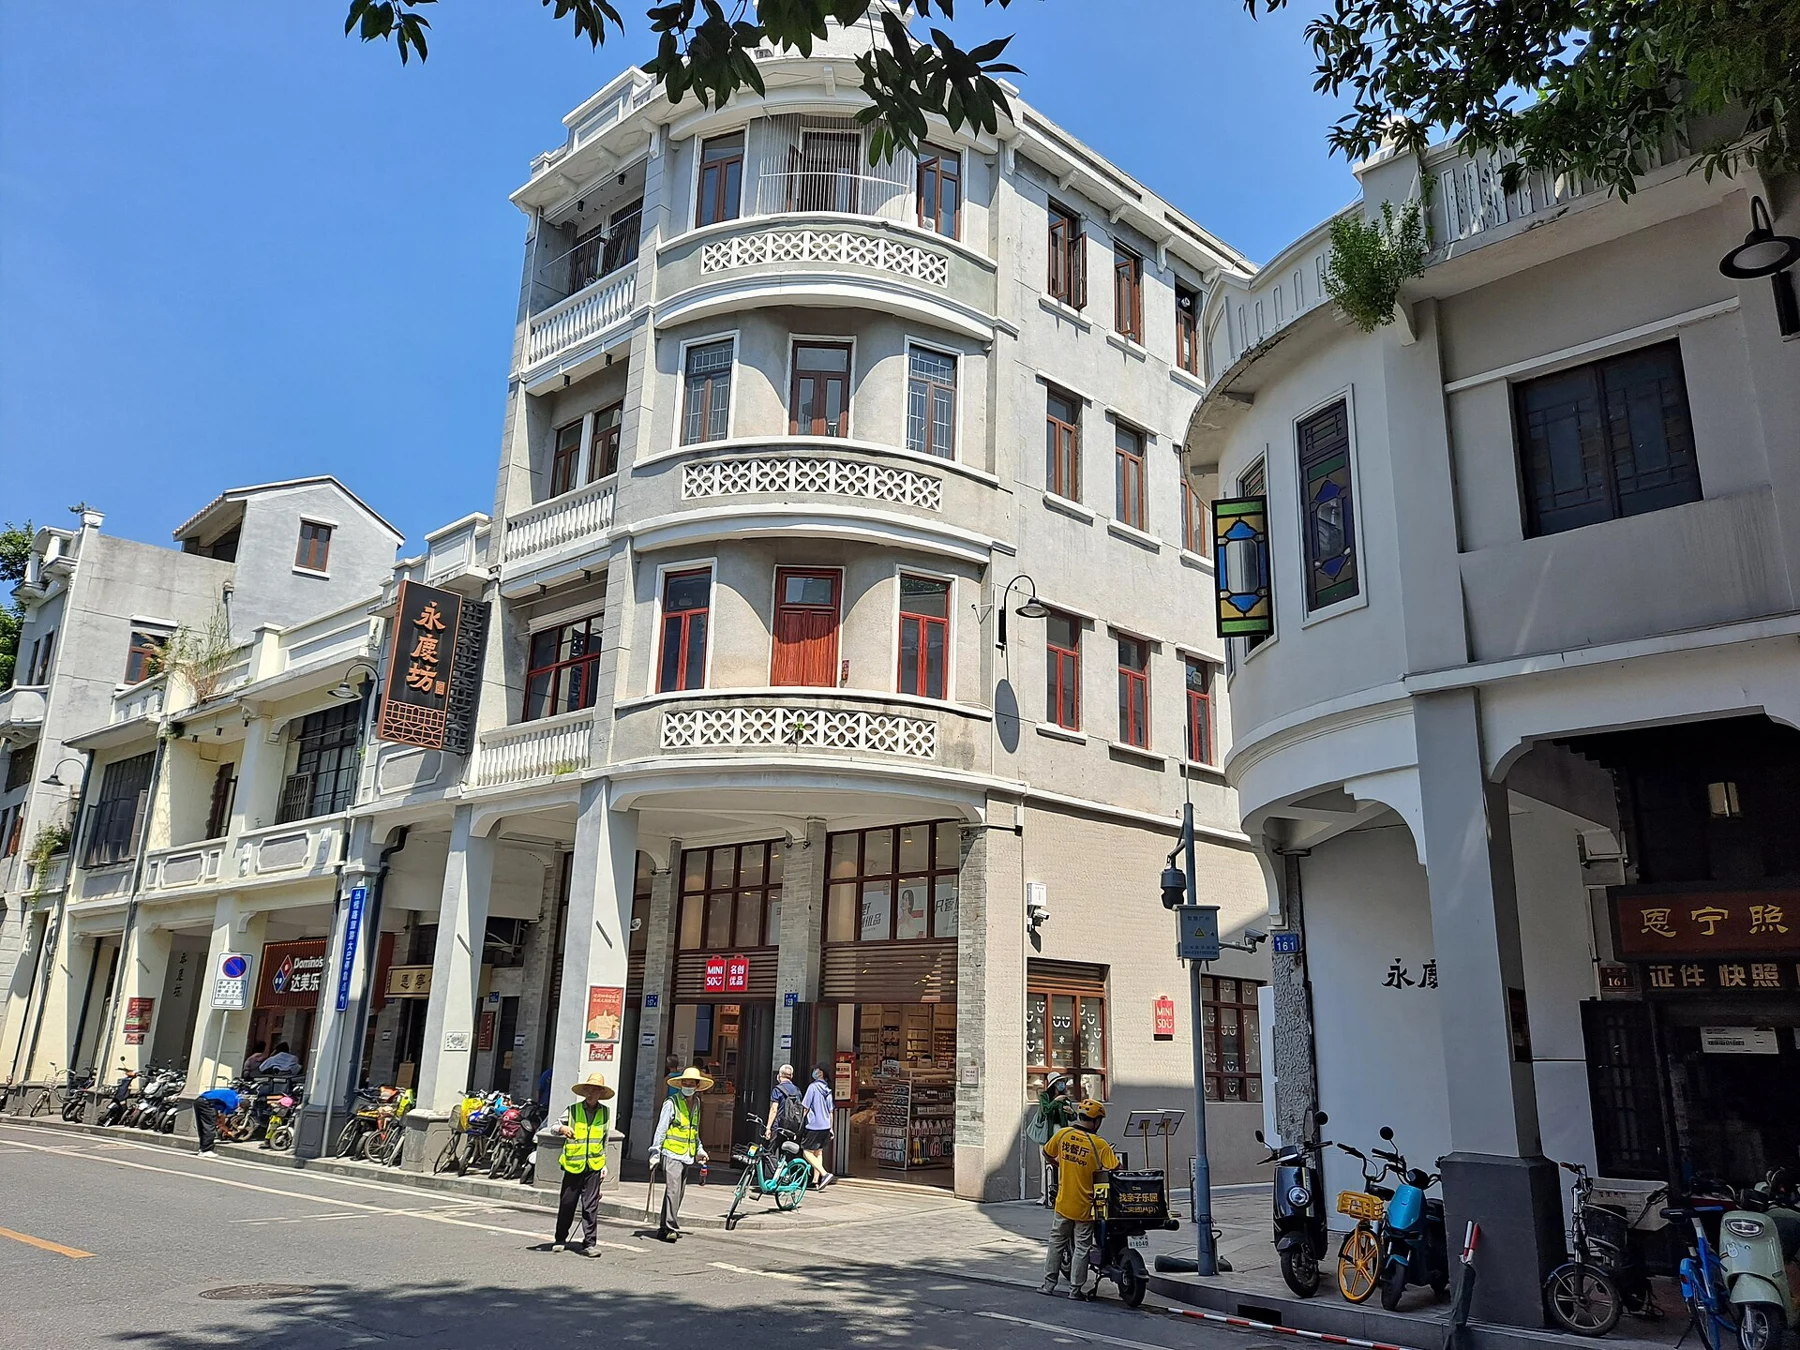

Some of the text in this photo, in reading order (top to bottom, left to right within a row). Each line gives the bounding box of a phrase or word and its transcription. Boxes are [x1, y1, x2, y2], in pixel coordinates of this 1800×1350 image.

[1640, 904, 1789, 938] 恩宁照
[1277, 941, 1295, 951] 161
[294, 956, 324, 969] Domino's
[707, 966, 723, 975] MINI
[730, 965, 745, 975] 名创
[290, 972, 321, 992] 达美乐
[729, 976, 744, 986] 优品
[1608, 977, 1628, 987] 161
[1156, 1007, 1173, 1017] MINI
[1062, 1141, 1090, 1158] 找餐厅
[1119, 1192, 1159, 1203] 找亲子乐园
